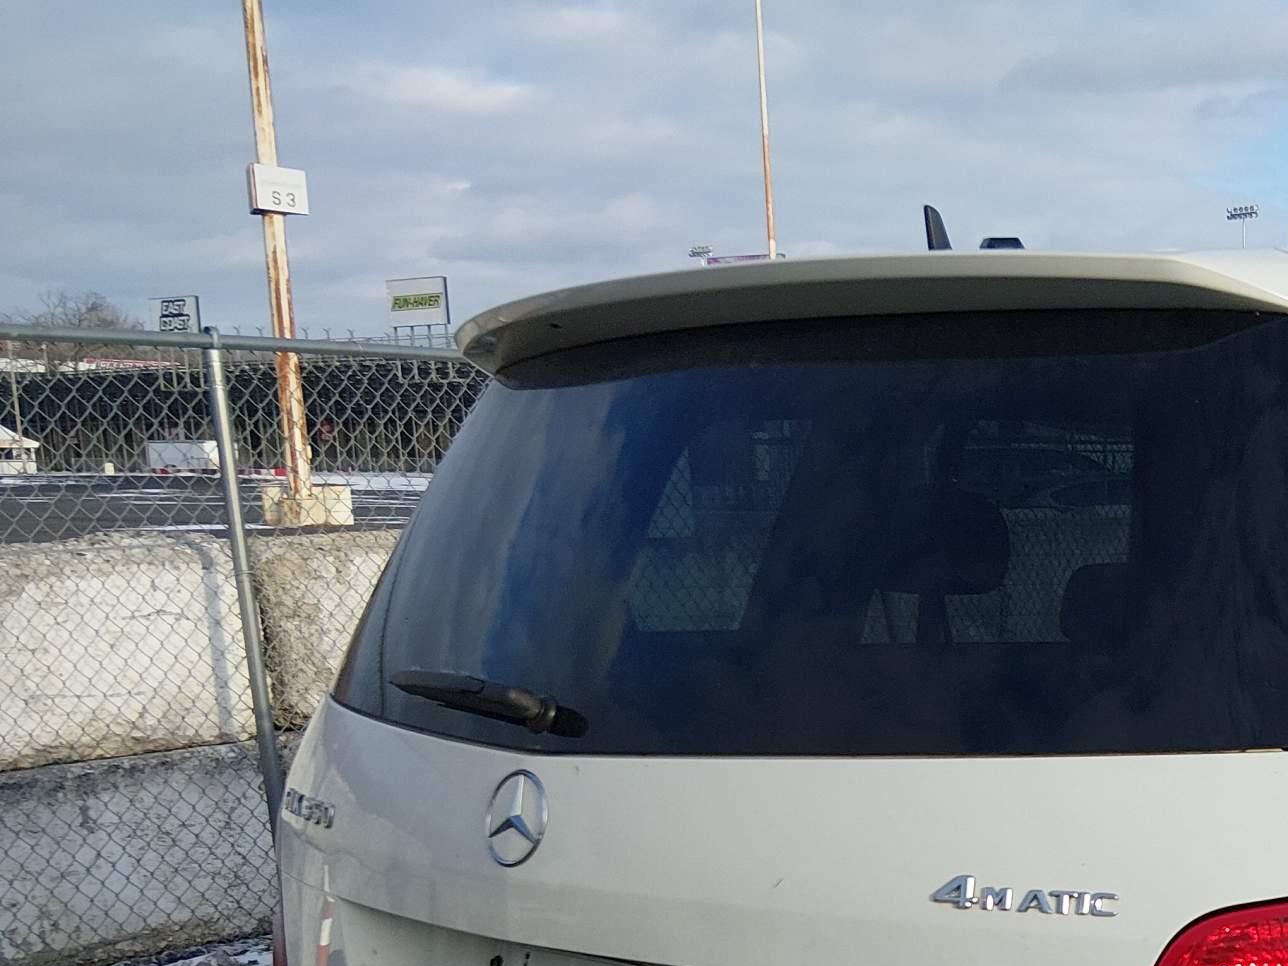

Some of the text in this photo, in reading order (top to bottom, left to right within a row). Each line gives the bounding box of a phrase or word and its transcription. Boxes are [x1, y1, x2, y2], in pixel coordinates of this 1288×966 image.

[161, 299, 186, 315] EAST
[160, 314, 191, 331] COAST
[929, 874, 1120, 917] 4MATIC
